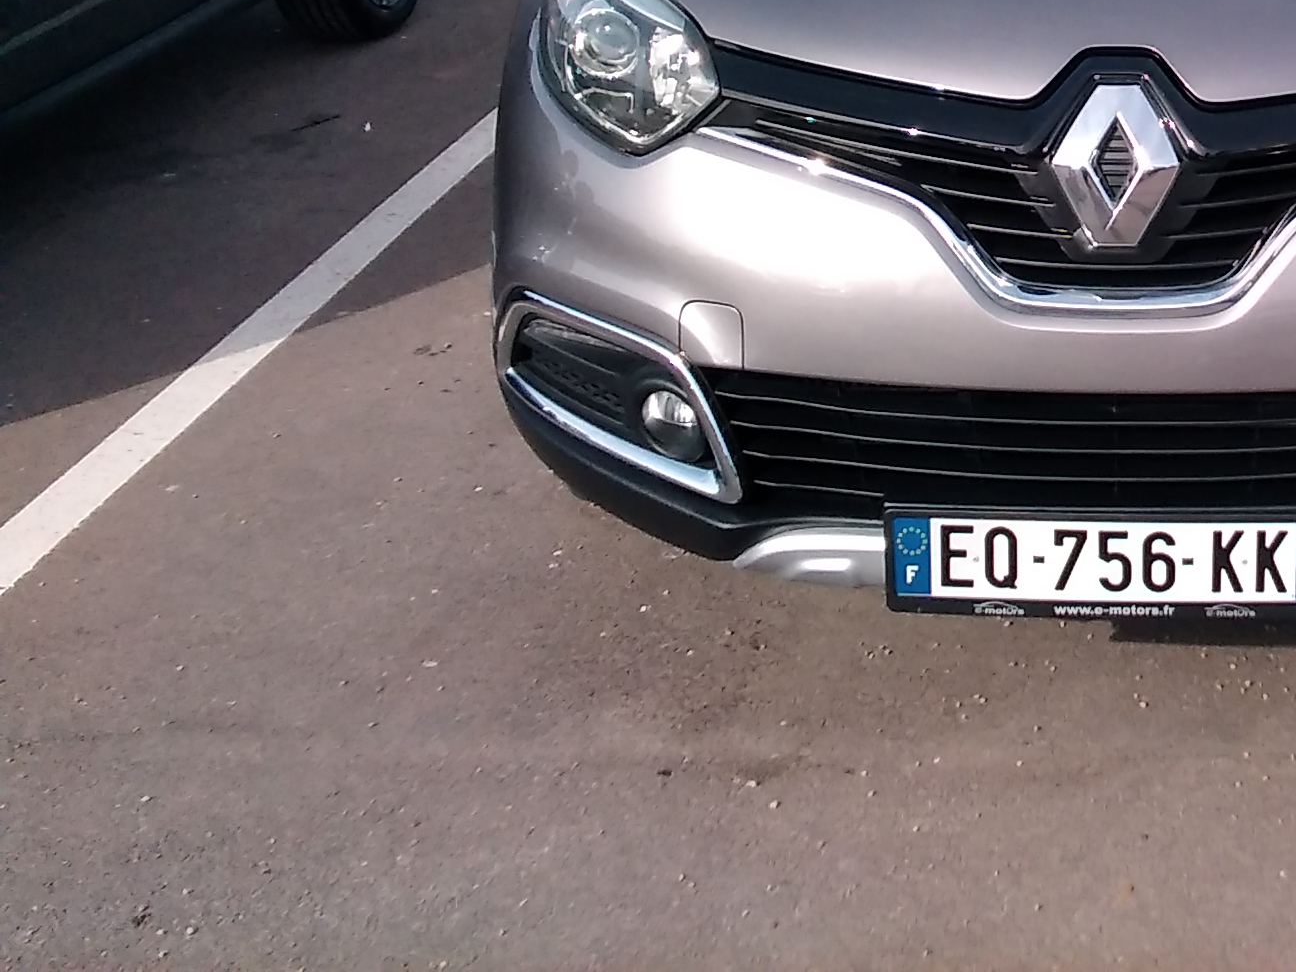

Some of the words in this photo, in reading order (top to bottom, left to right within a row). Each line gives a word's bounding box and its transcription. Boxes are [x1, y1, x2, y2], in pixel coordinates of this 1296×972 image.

[940, 524, 1288, 594] EQ-756-KK
[906, 565, 919, 584] F
[1053, 604, 1175, 616] www.e-motors.fr
